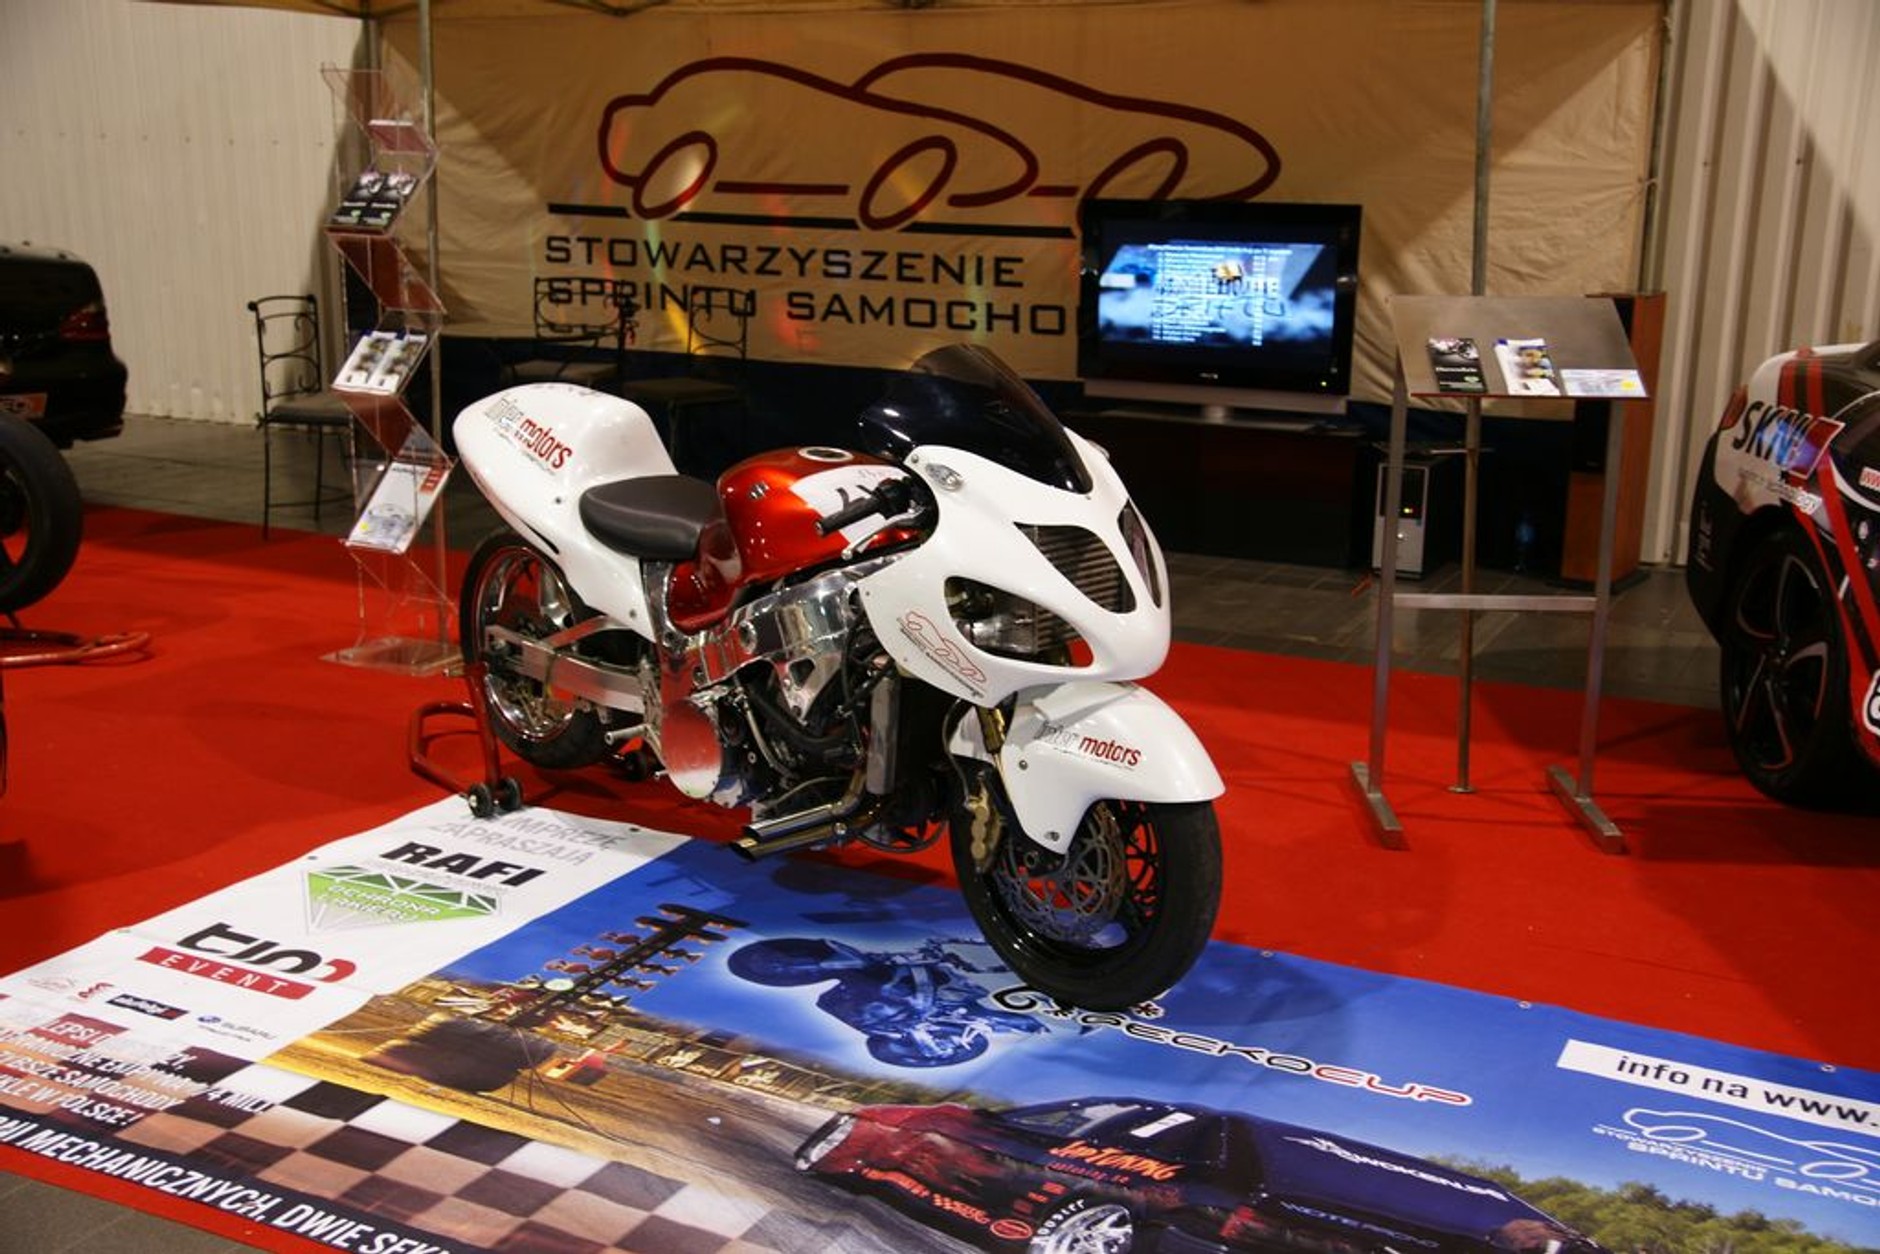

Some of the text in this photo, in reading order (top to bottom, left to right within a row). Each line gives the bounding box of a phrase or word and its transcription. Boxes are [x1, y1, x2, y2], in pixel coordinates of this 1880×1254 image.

[545, 235, 1024, 288] STOWARZYSZENIE
[548, 278, 1079, 337] SPRINTU SAMOCHO
[1079, 736, 1141, 767] motors
[380, 841, 547, 887] RAFI
[157, 953, 290, 993] EVENT
[1616, 1055, 1689, 1086] info
[1699, 1076, 1749, 1100] na
[15, 1127, 272, 1222] MECHANICZNYCH,
[273, 1202, 376, 1249] DWIE
[1774, 1177, 1880, 1207] SAMO
